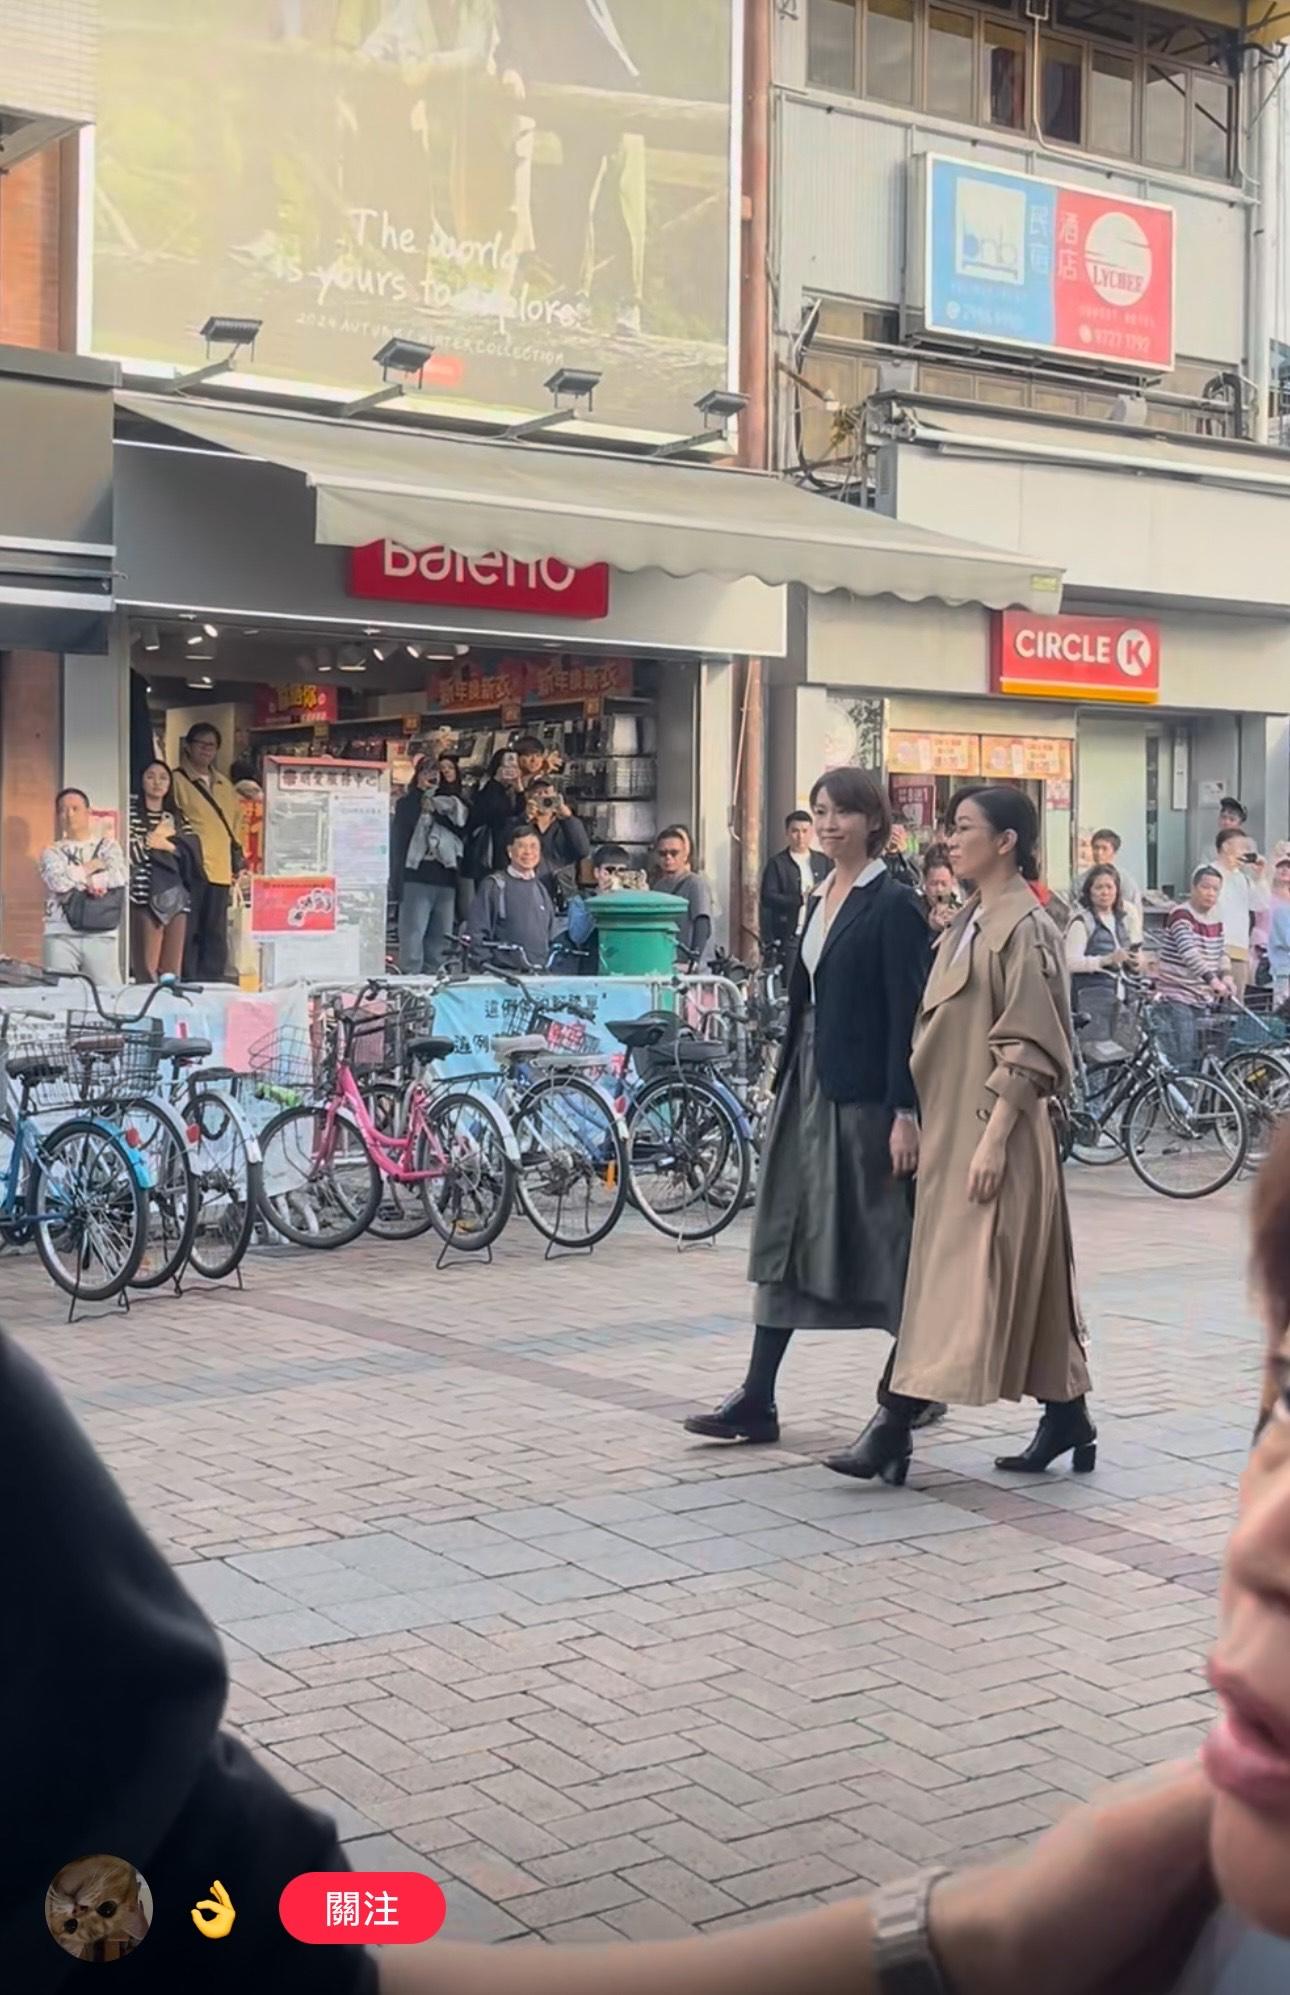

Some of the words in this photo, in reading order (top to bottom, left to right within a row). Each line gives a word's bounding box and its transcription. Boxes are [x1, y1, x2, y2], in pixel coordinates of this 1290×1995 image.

[350, 208, 419, 254] The
[309, 262, 407, 306] yours
[420, 273, 451, 308] to
[1093, 264, 1145, 293] LYCHEE
[384, 538, 576, 591] Baleno
[1015, 629, 1111, 664] CIRCLE
[1122, 634, 1149, 672] K
